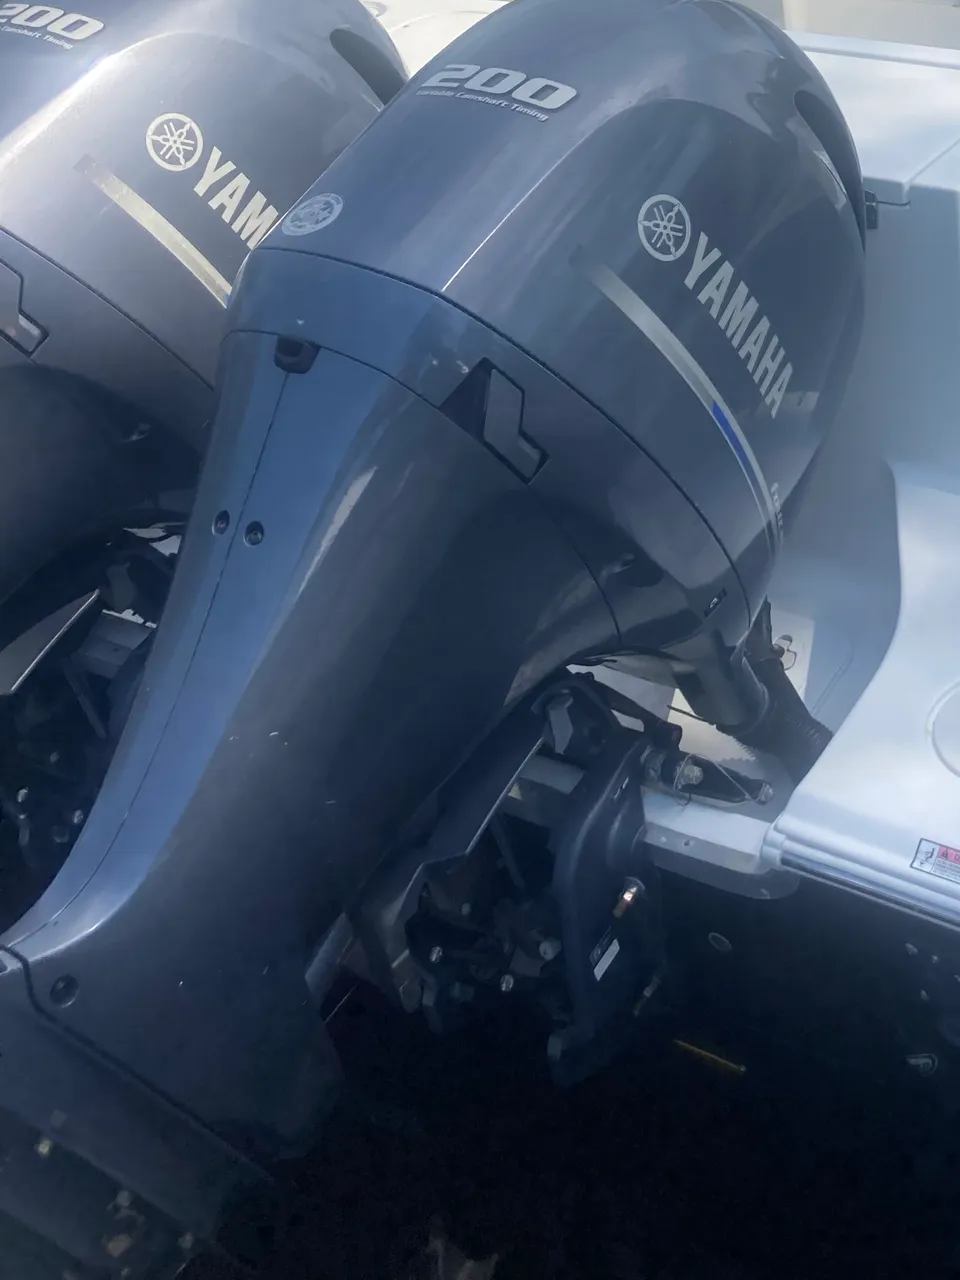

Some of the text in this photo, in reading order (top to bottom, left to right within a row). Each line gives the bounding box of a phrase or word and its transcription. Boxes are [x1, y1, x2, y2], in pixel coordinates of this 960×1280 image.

[0, 4, 104, 40] 200
[420, 64, 577, 109] 200
[455, 91, 510, 108] Camshaft
[510, 103, 550, 122] Timing
[193, 146, 279, 250] YAM
[683, 232, 795, 419] YAMAHA
